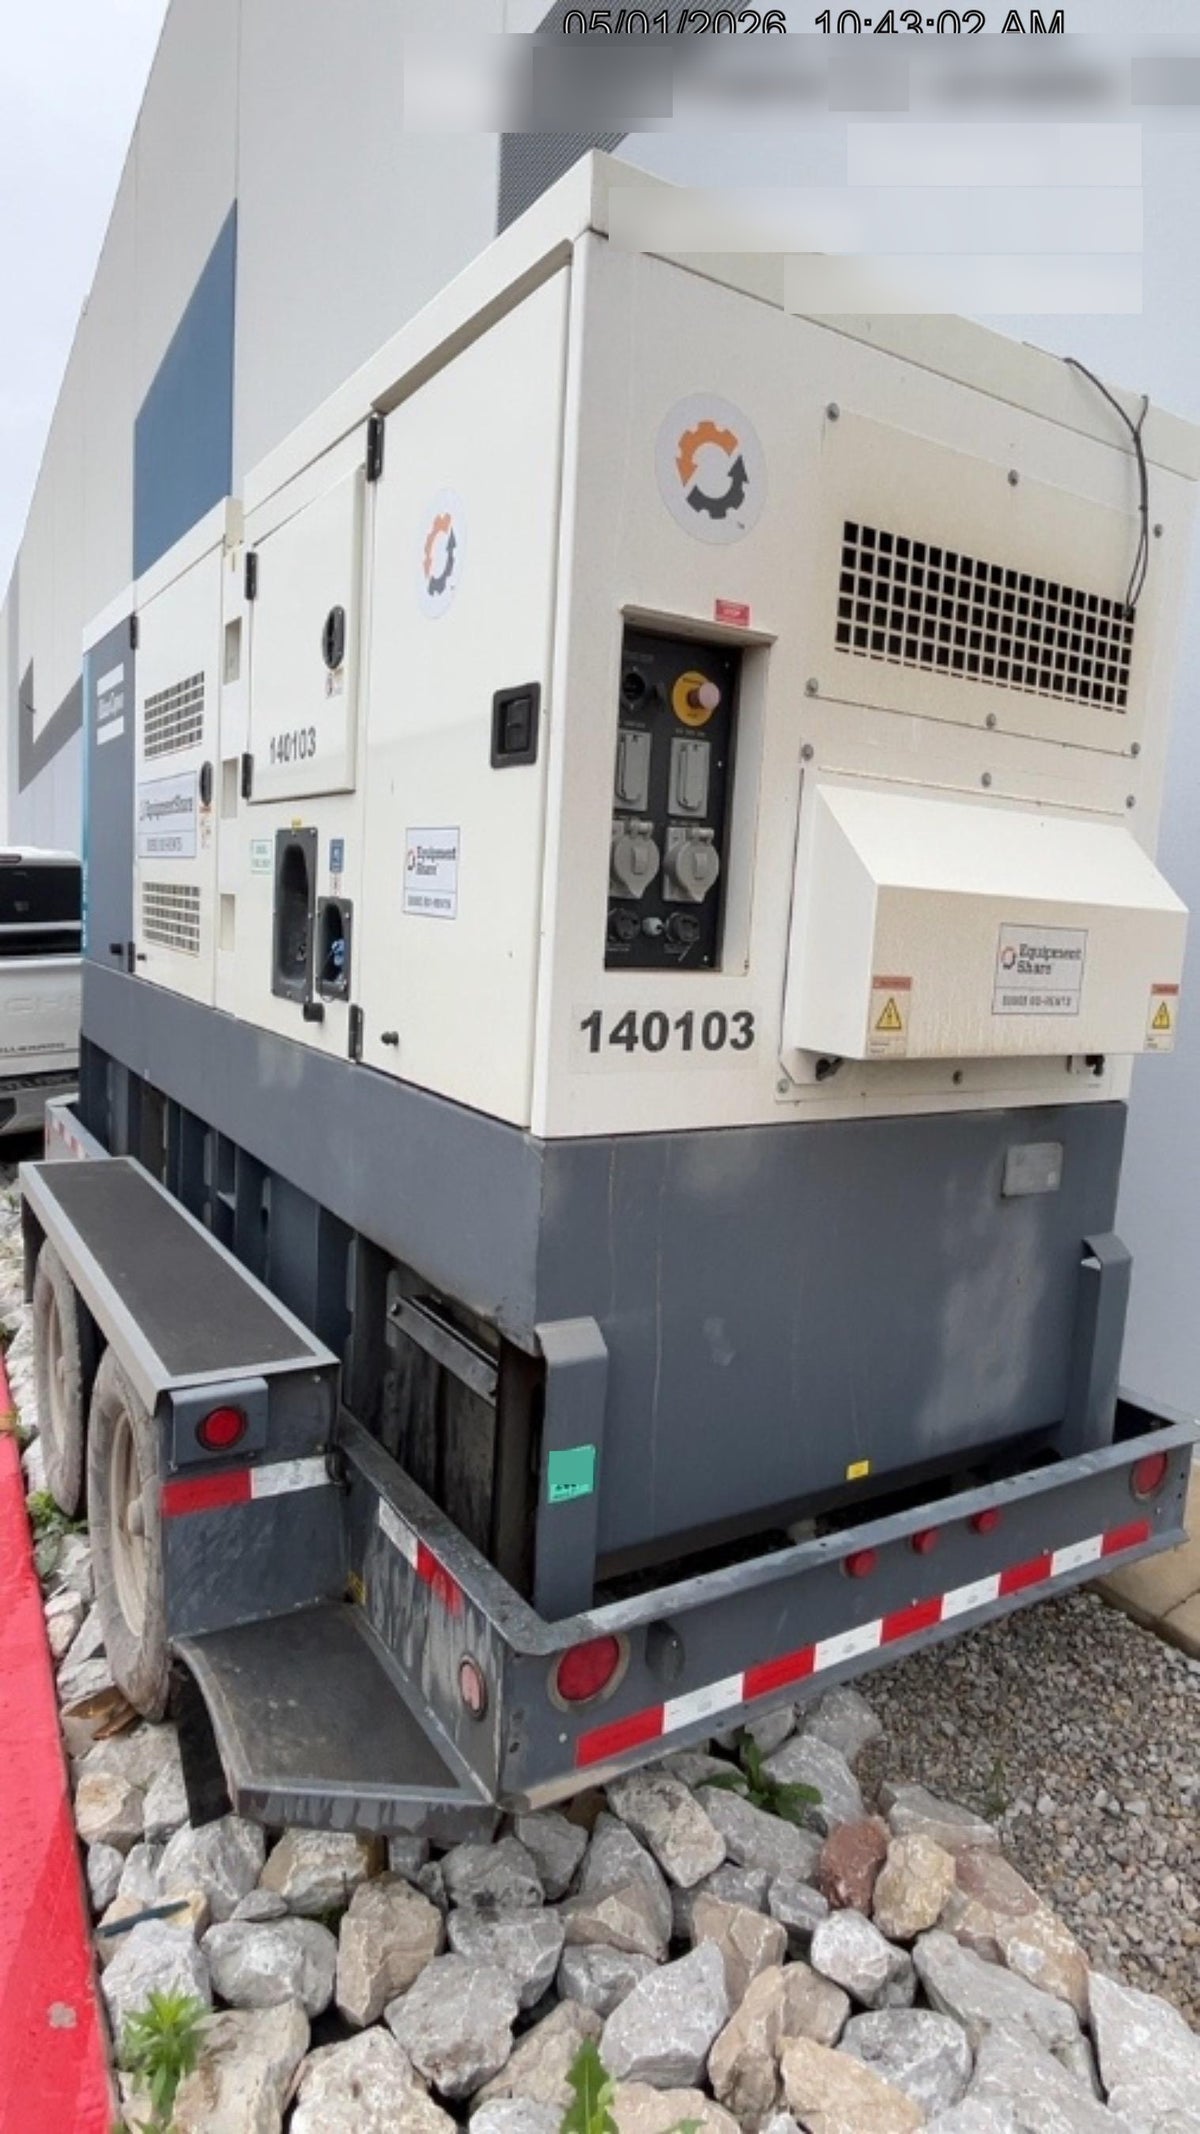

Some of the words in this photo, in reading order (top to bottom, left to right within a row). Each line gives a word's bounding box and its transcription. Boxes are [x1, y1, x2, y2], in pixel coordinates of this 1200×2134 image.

[269, 726, 316, 765] 140103
[1018, 943, 1082, 961] Equipment
[1016, 960, 1052, 975] Share
[578, 1009, 756, 1054] 140103
